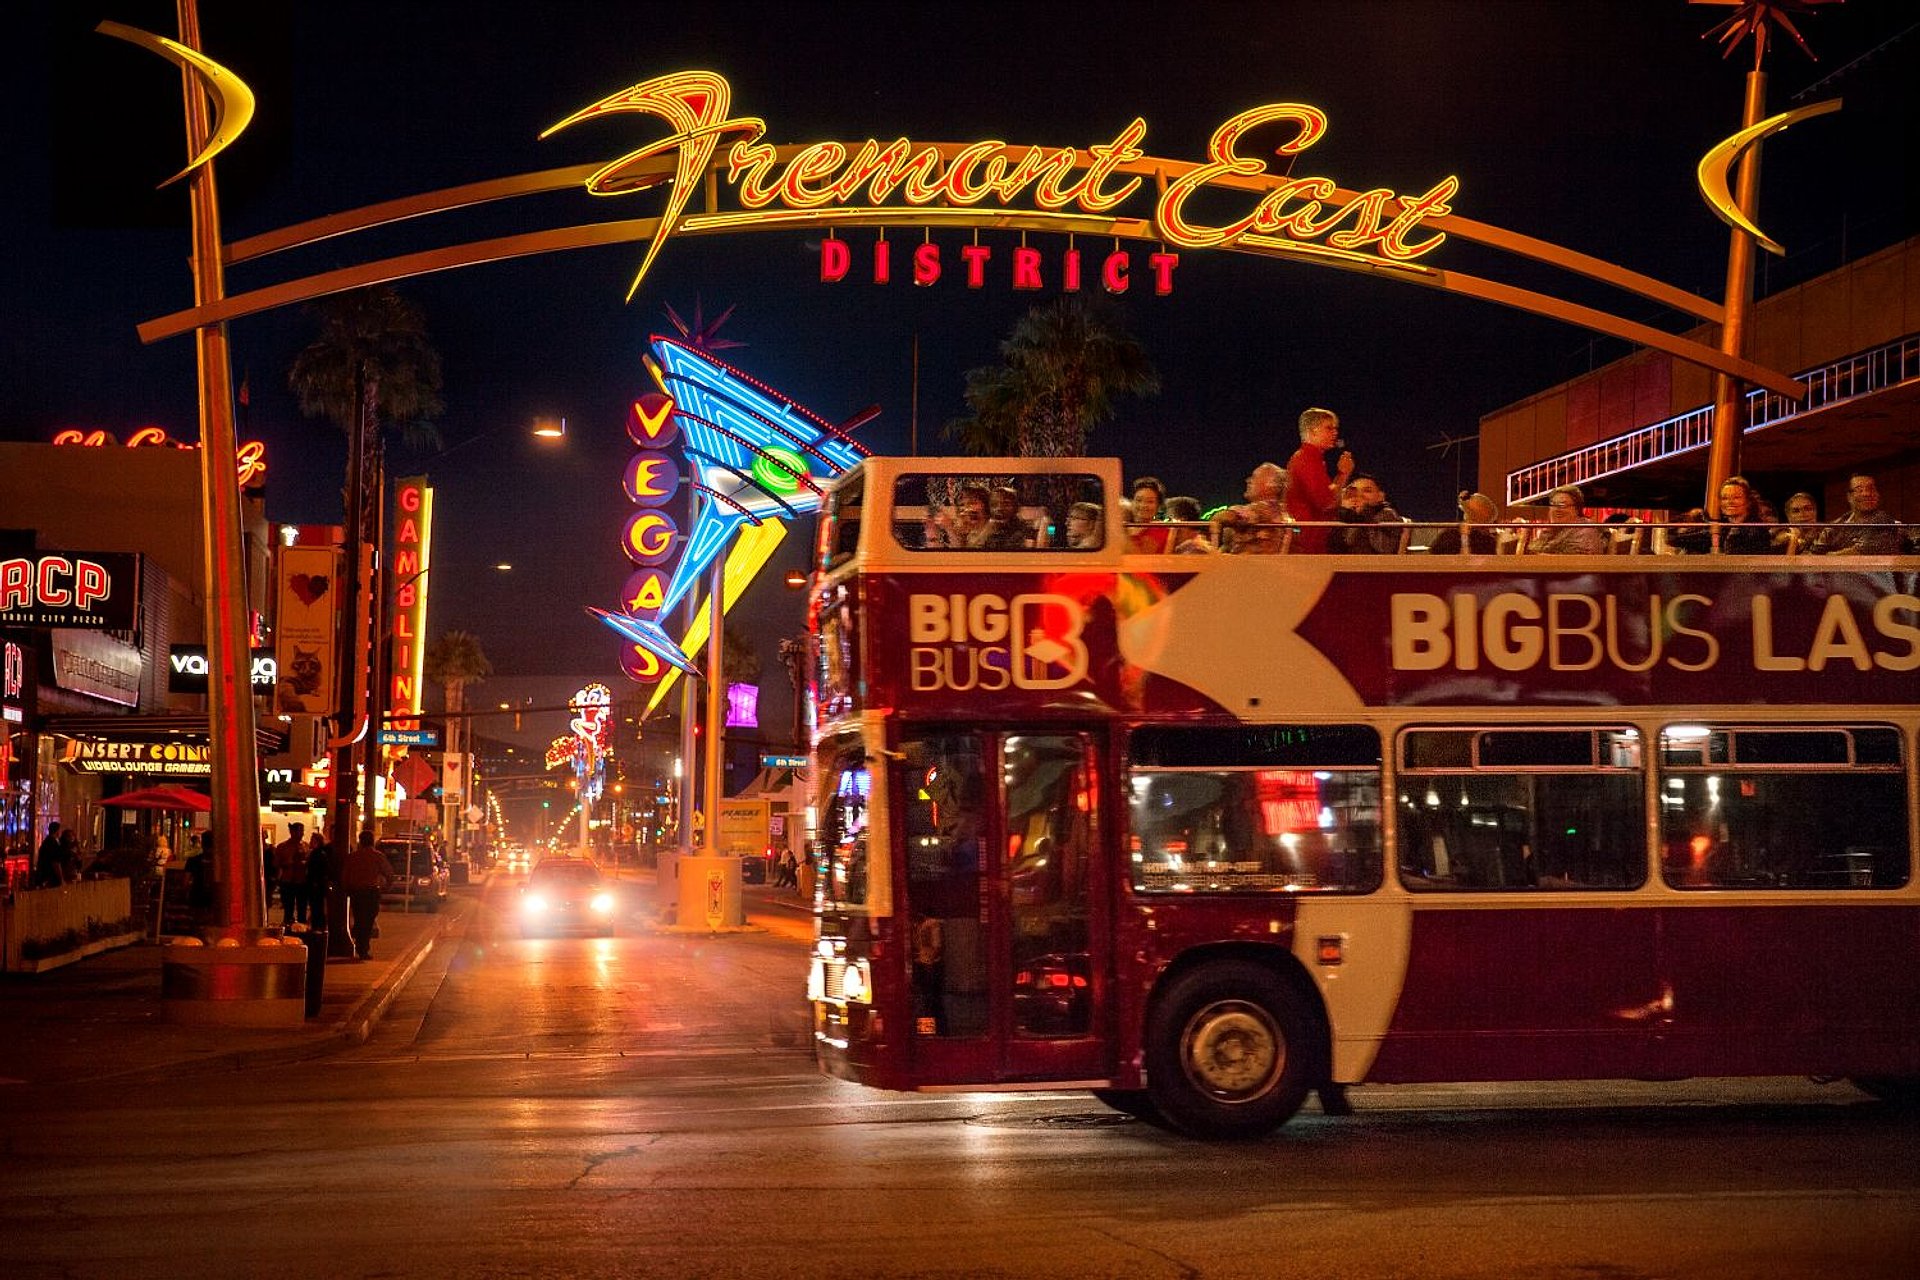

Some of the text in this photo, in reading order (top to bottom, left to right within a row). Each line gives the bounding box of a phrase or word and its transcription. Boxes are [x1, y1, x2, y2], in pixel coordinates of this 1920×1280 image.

[537, 70, 1459, 304] Fremont East
[820, 238, 1179, 296] DISTRICT
[0, 556, 111, 611] RCP
[41, 614, 65, 623] CITY
[72, 615, 103, 624] PIZZA
[395, 487, 421, 731] GAMBLING
[910, 593, 1009, 643] BIG
[1752, 593, 1920, 672] LAS
[911, 647, 1011, 691] BUS
[75, 741, 145, 759] INSERT
[397, 733, 420, 743] Street
[165, 762, 211, 773] GAMEBA
[788, 758, 807, 767] Street
